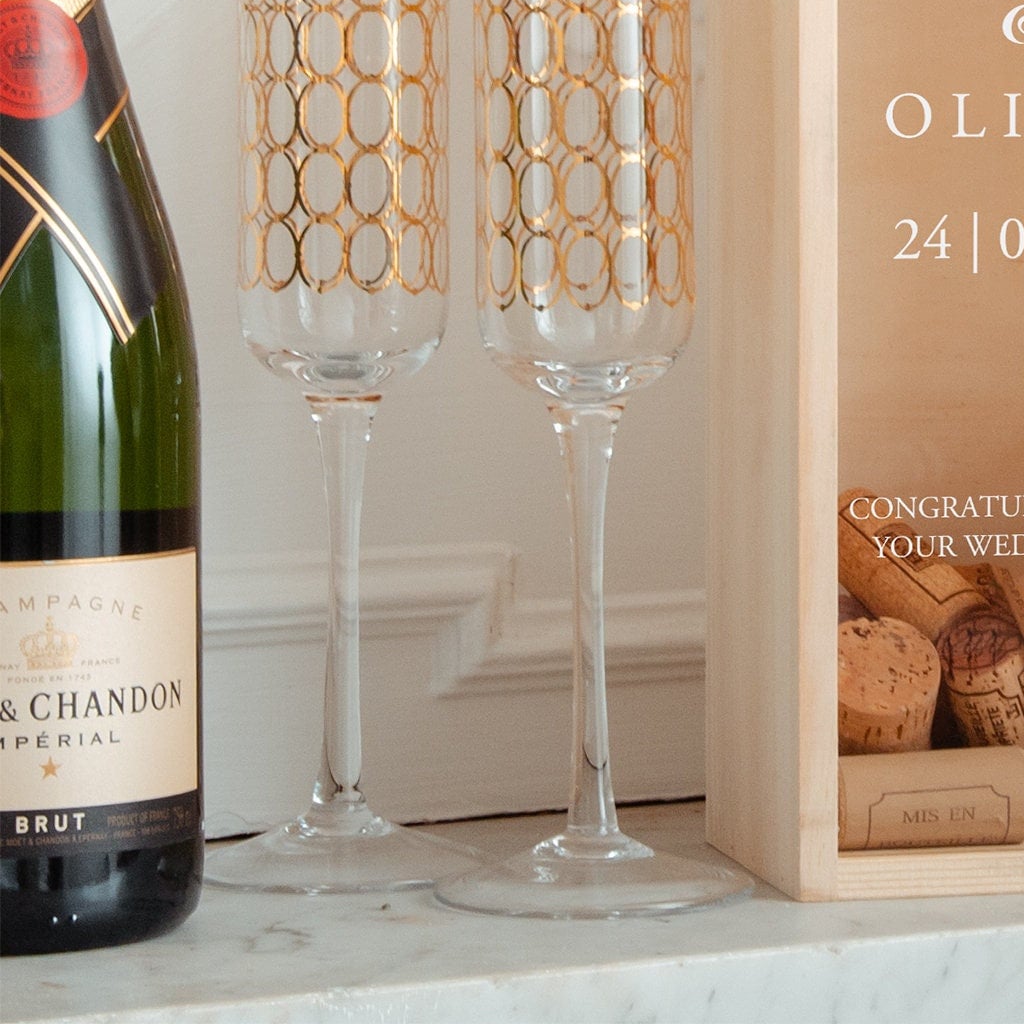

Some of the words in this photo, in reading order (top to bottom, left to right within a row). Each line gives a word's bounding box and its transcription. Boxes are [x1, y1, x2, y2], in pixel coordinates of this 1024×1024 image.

[872, 534, 957, 558] YOUR
[0, 699, 19, 722] &
[30, 680, 182, 722] CHANDON
[16, 812, 86, 834] BRUT
[902, 809, 940, 824] MIS
[950, 806, 976, 822] EN
